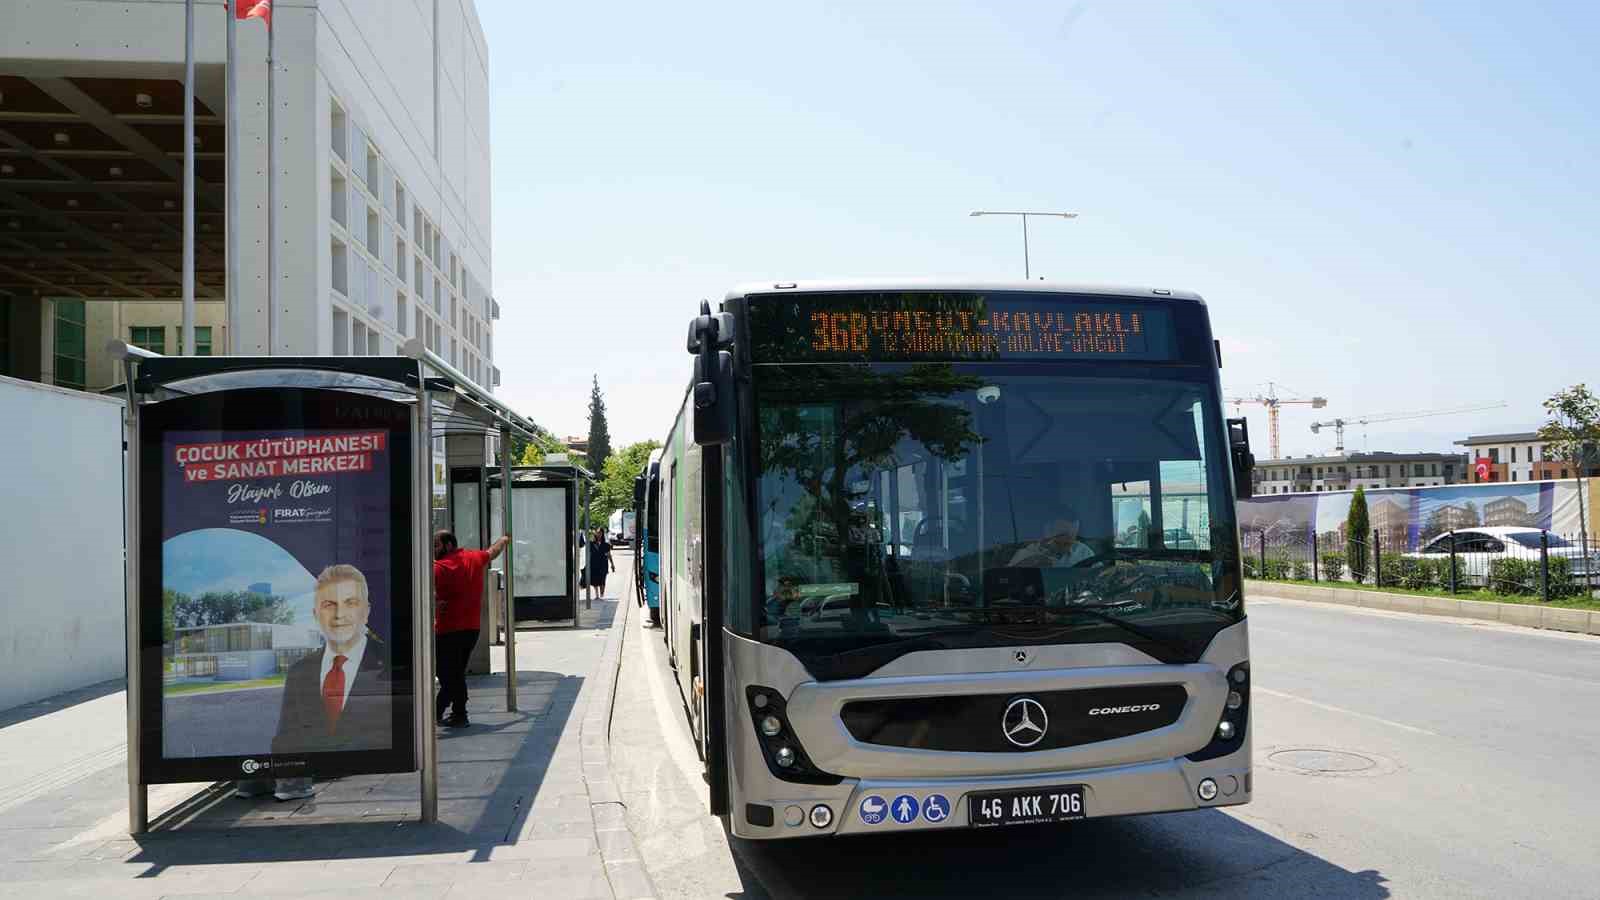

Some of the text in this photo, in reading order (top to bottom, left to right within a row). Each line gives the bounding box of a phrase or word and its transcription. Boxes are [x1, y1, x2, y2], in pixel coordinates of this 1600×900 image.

[811, 312, 868, 351] 36B
[176, 435, 378, 467] ÇOCUK KÜTÜPHANESİ
[187, 469, 208, 480] ve
[214, 460, 277, 479] SANAT
[289, 479, 331, 498] Olsun
[274, 508, 304, 518] FIRAT
[1088, 703, 1161, 716] CONECTO
[981, 793, 1081, 819] 46 AKK 706
